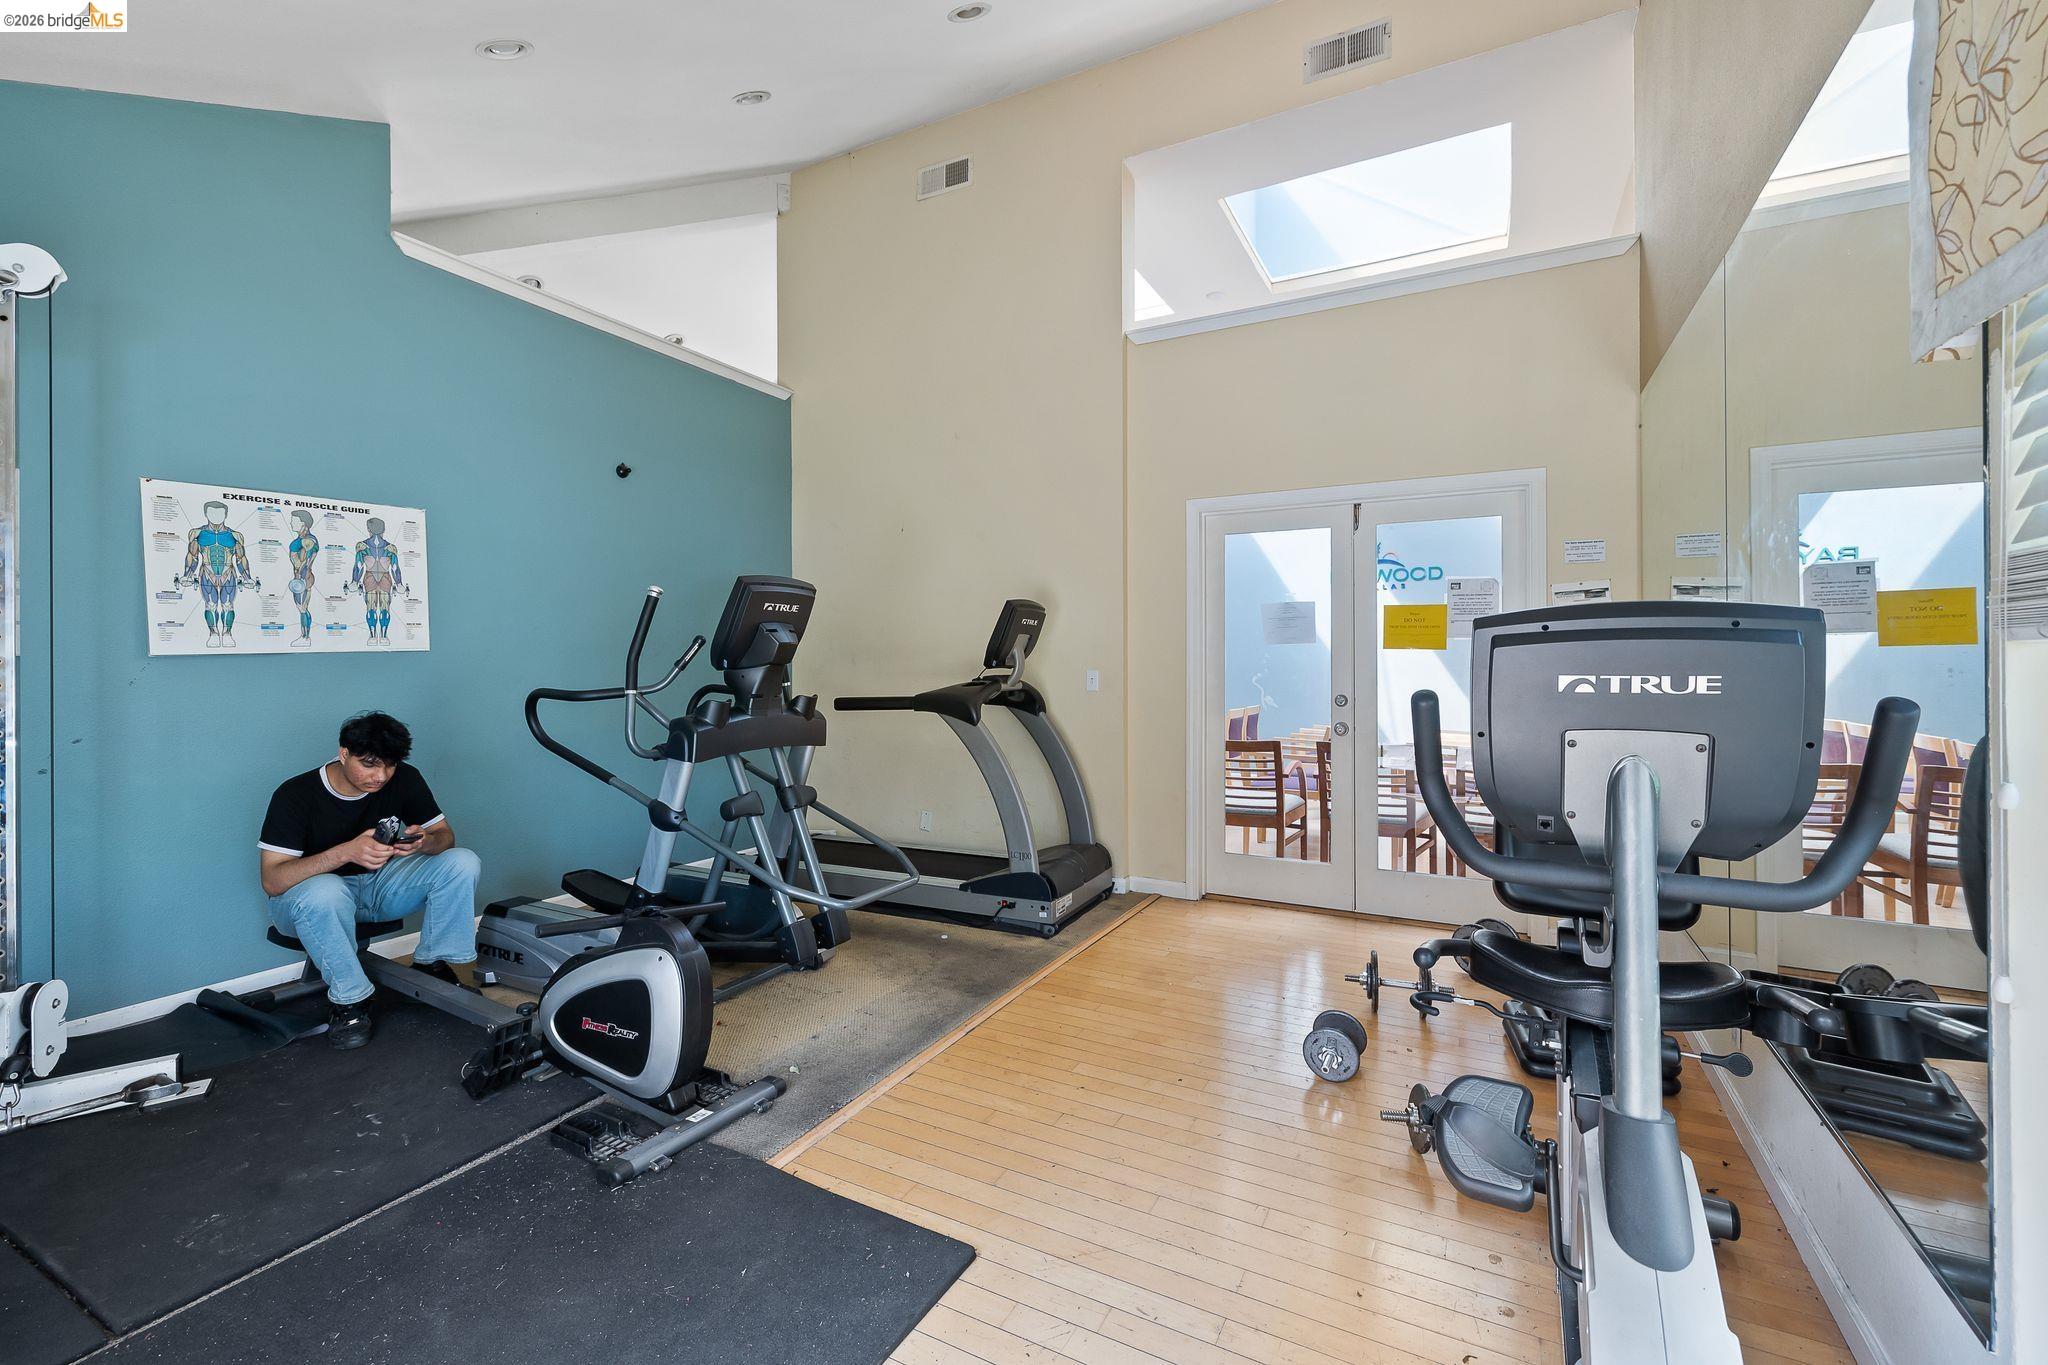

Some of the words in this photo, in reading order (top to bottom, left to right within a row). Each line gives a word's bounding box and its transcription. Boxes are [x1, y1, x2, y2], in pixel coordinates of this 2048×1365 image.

[222, 493, 281, 505] EXERCISE
[295, 500, 339, 512] MUSCLE
[341, 506, 371, 515] GUIDE
[774, 603, 800, 613] TRUE
[1600, 675, 1723, 695] TRUE
[491, 946, 524, 965] TRUE
